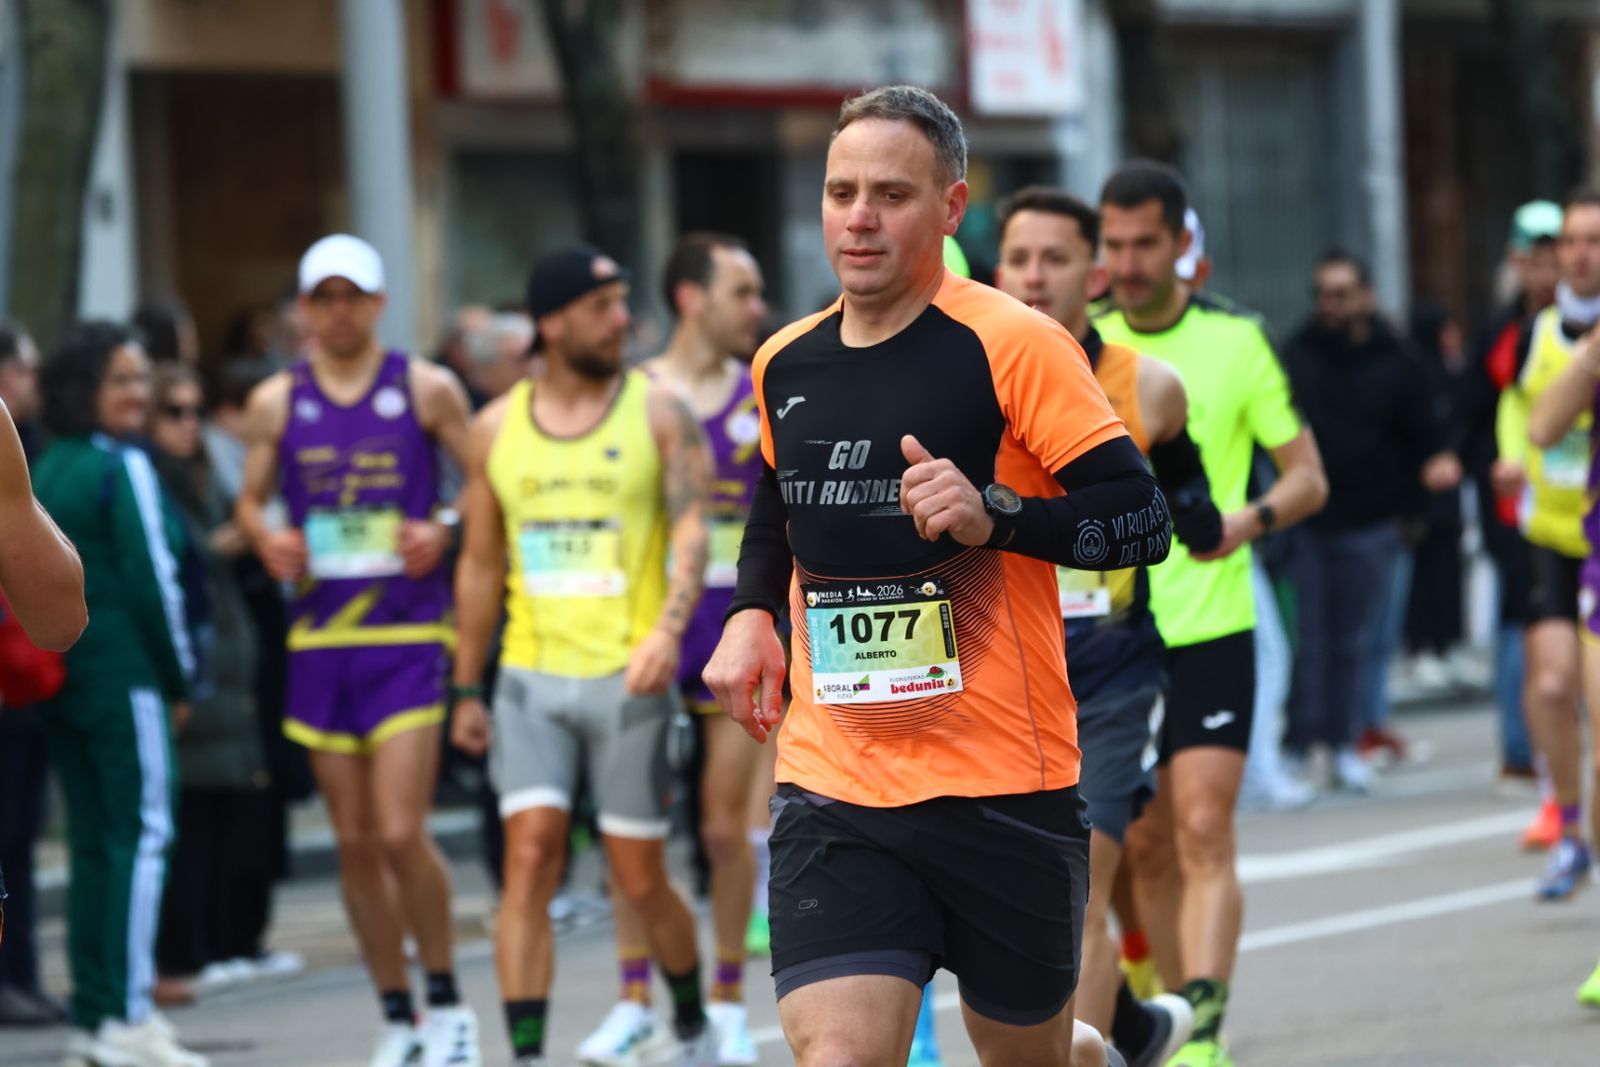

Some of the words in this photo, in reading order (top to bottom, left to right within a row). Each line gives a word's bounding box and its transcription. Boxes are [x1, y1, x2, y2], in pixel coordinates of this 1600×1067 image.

[828, 440, 872, 470] GO
[1112, 515, 1125, 540] VI
[1119, 541, 1142, 566] DEL
[876, 584, 904, 597] 2026
[829, 609, 921, 645] 1077
[854, 650, 897, 660] ALBERTO
